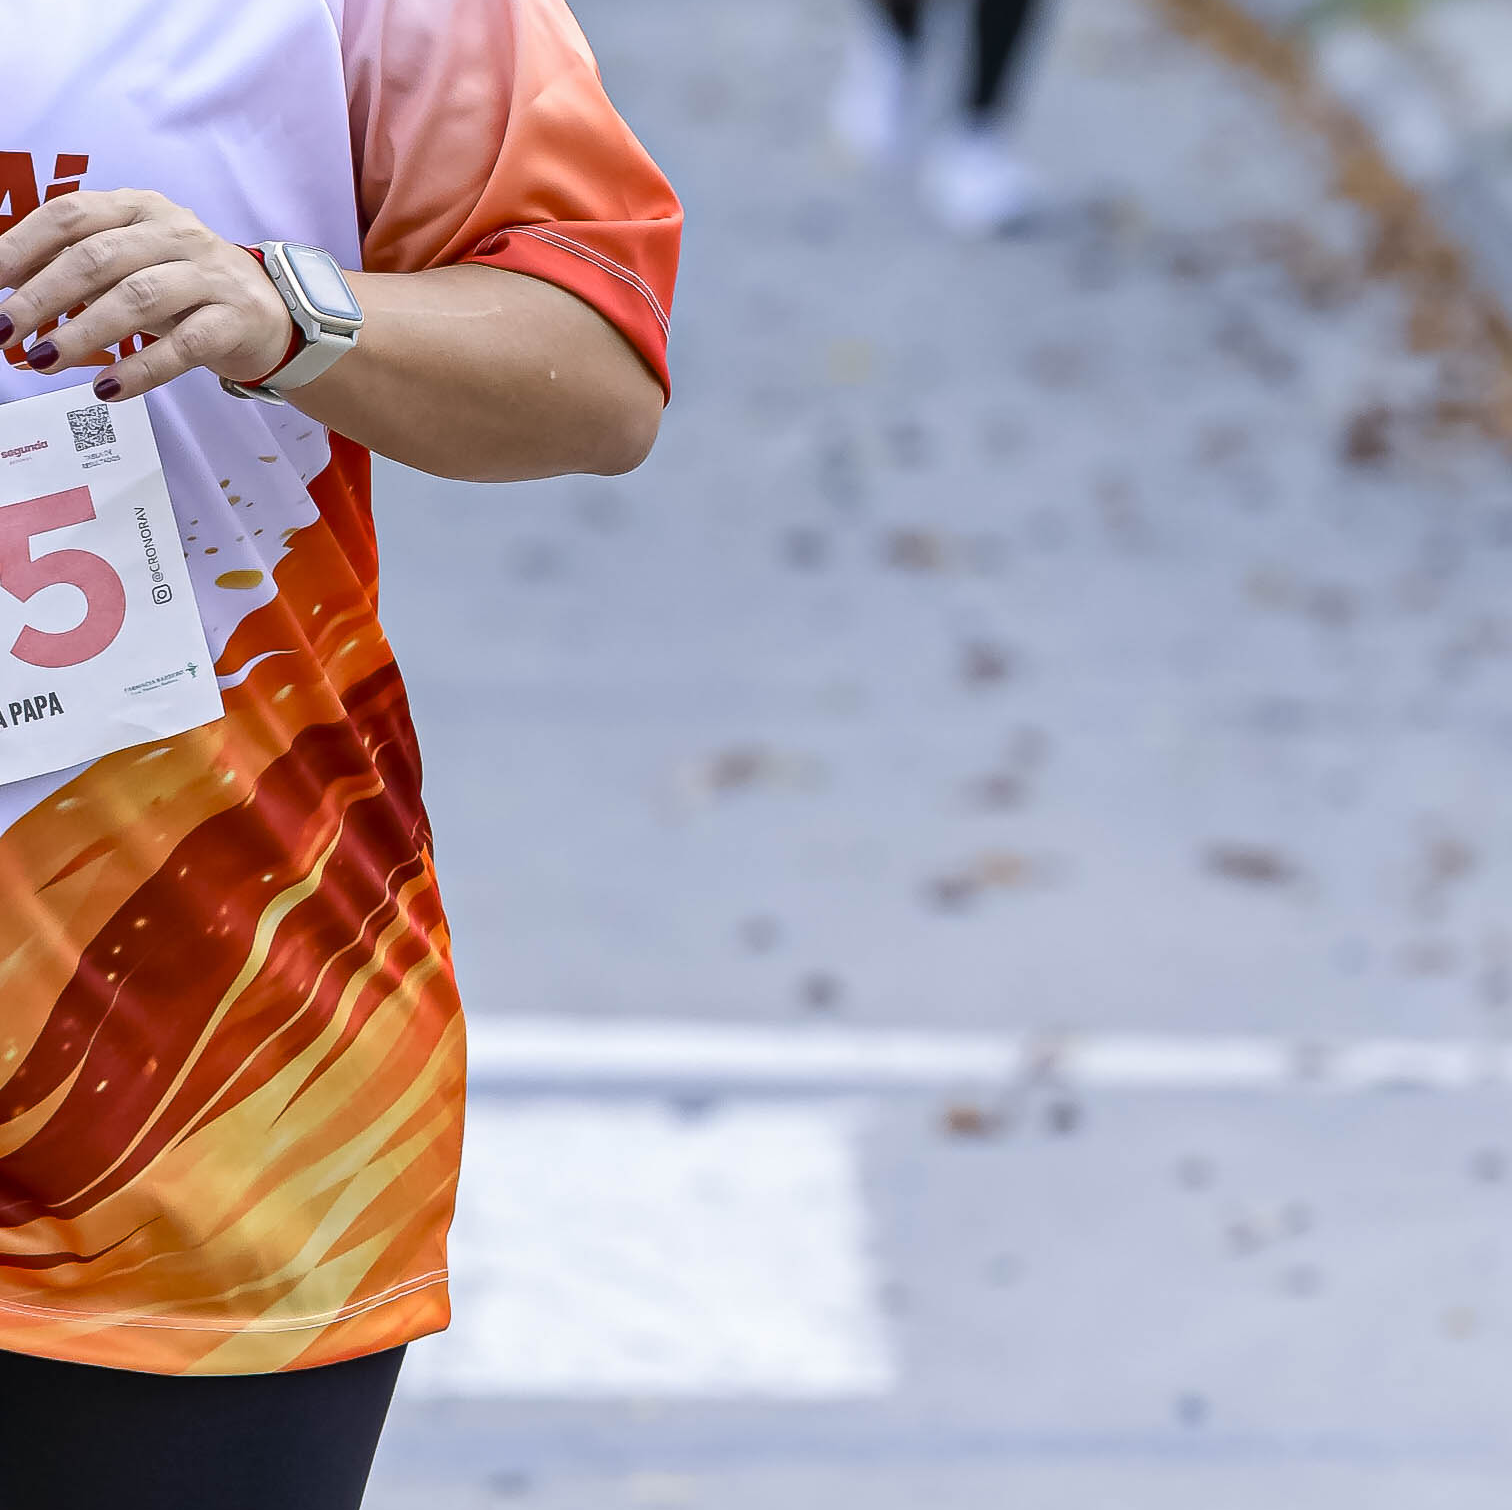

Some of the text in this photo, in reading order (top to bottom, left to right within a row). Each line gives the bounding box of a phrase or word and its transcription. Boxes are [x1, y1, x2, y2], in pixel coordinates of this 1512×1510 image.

[0, 440, 49, 458] segunda
[133, 507, 164, 583] @CRONORAV
[8, 691, 65, 727] PAPA
